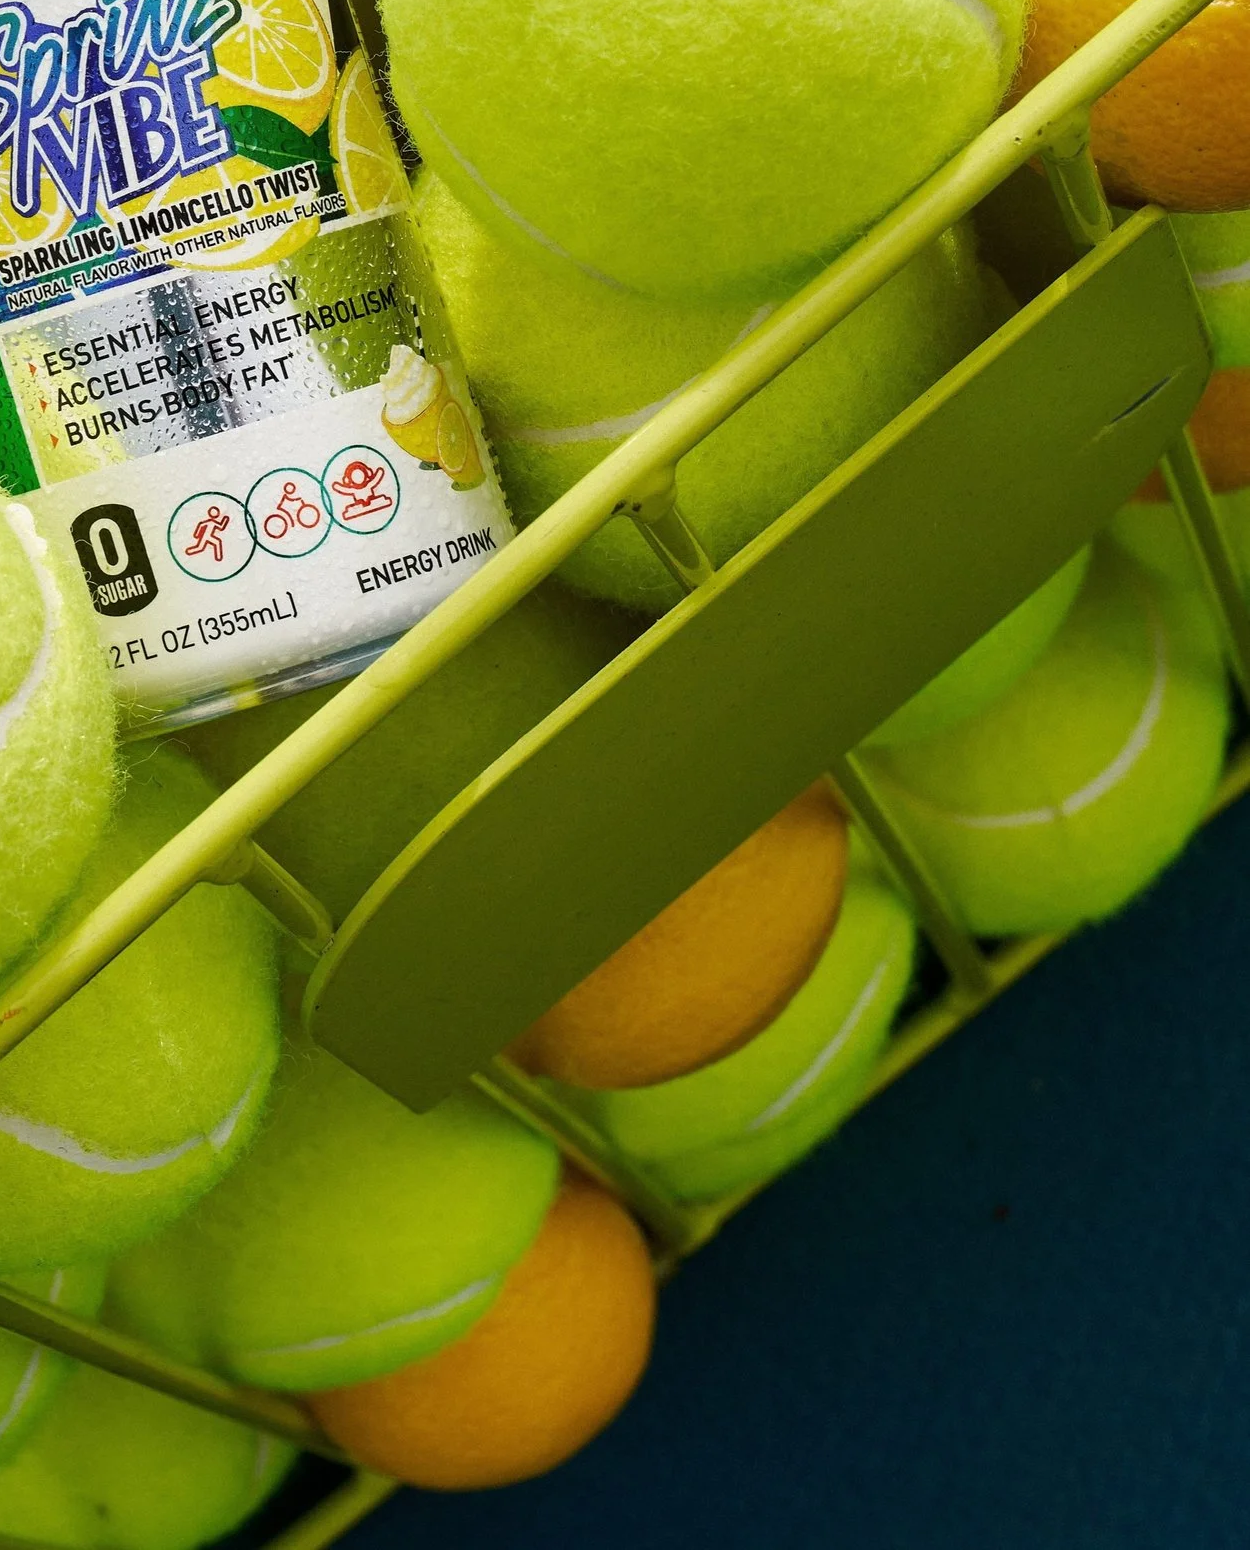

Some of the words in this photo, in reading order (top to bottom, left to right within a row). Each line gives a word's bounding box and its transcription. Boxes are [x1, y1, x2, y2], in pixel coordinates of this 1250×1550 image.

[32, 50, 237, 220] VIBE
[117, 183, 254, 246] LIMONCELLO
[254, 163, 320, 203] TWIST
[7, 278, 72, 310] NATURAL
[72, 258, 130, 288] FLAVOR
[131, 246, 173, 270] WITH
[176, 230, 226, 256] OTHER
[227, 210, 293, 241] NATURAL
[293, 193, 347, 221] FLAVORS
[43, 314, 190, 376] ESSENTIAL
[194, 276, 298, 329] ENERGY
[57, 332, 245, 412] ACCELERATES
[64, 399, 157, 447] BURNS
[161, 373, 235, 417] BODY
[89, 518, 129, 576] 0
[355, 544, 443, 594] ENERGY
[445, 526, 497, 564] DRINK
[97, 574, 149, 607] SUGAR
[105, 646, 125, 670] 2
[126, 638, 158, 665] FL
[161, 625, 196, 654] OZ
[198, 591, 298, 645] (355mL)
